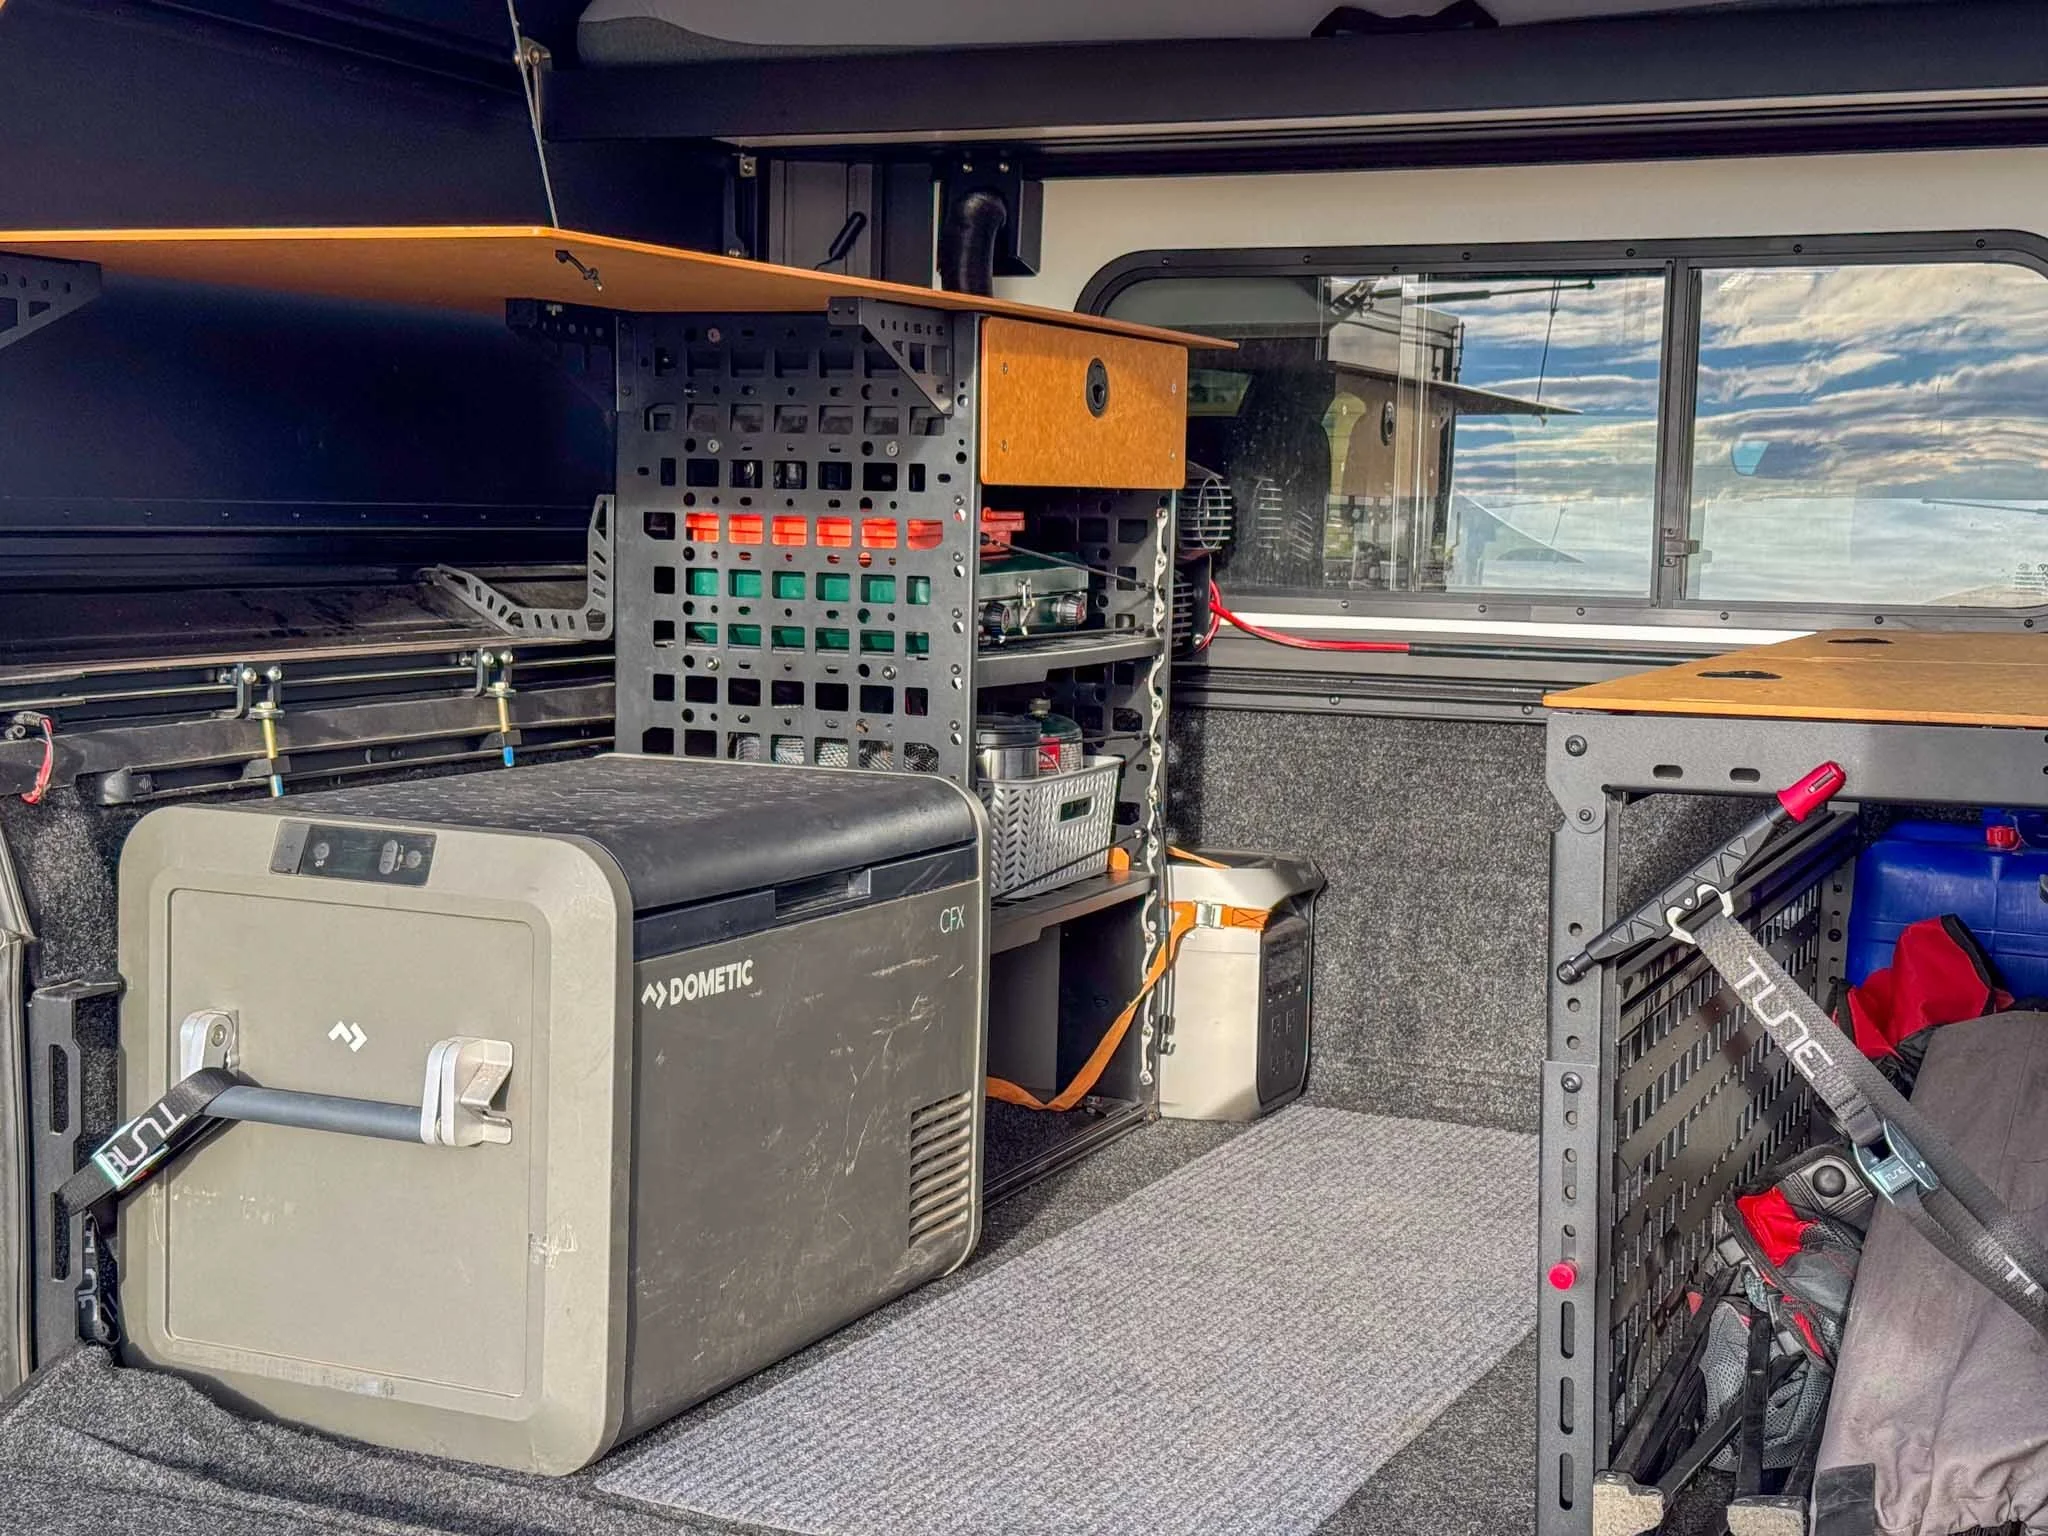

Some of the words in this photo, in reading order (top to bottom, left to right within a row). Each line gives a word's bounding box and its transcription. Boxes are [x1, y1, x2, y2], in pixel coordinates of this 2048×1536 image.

[939, 904, 966, 934] CFX
[670, 959, 754, 1006] DOMETIC
[1734, 955, 1834, 1079] TUNE
